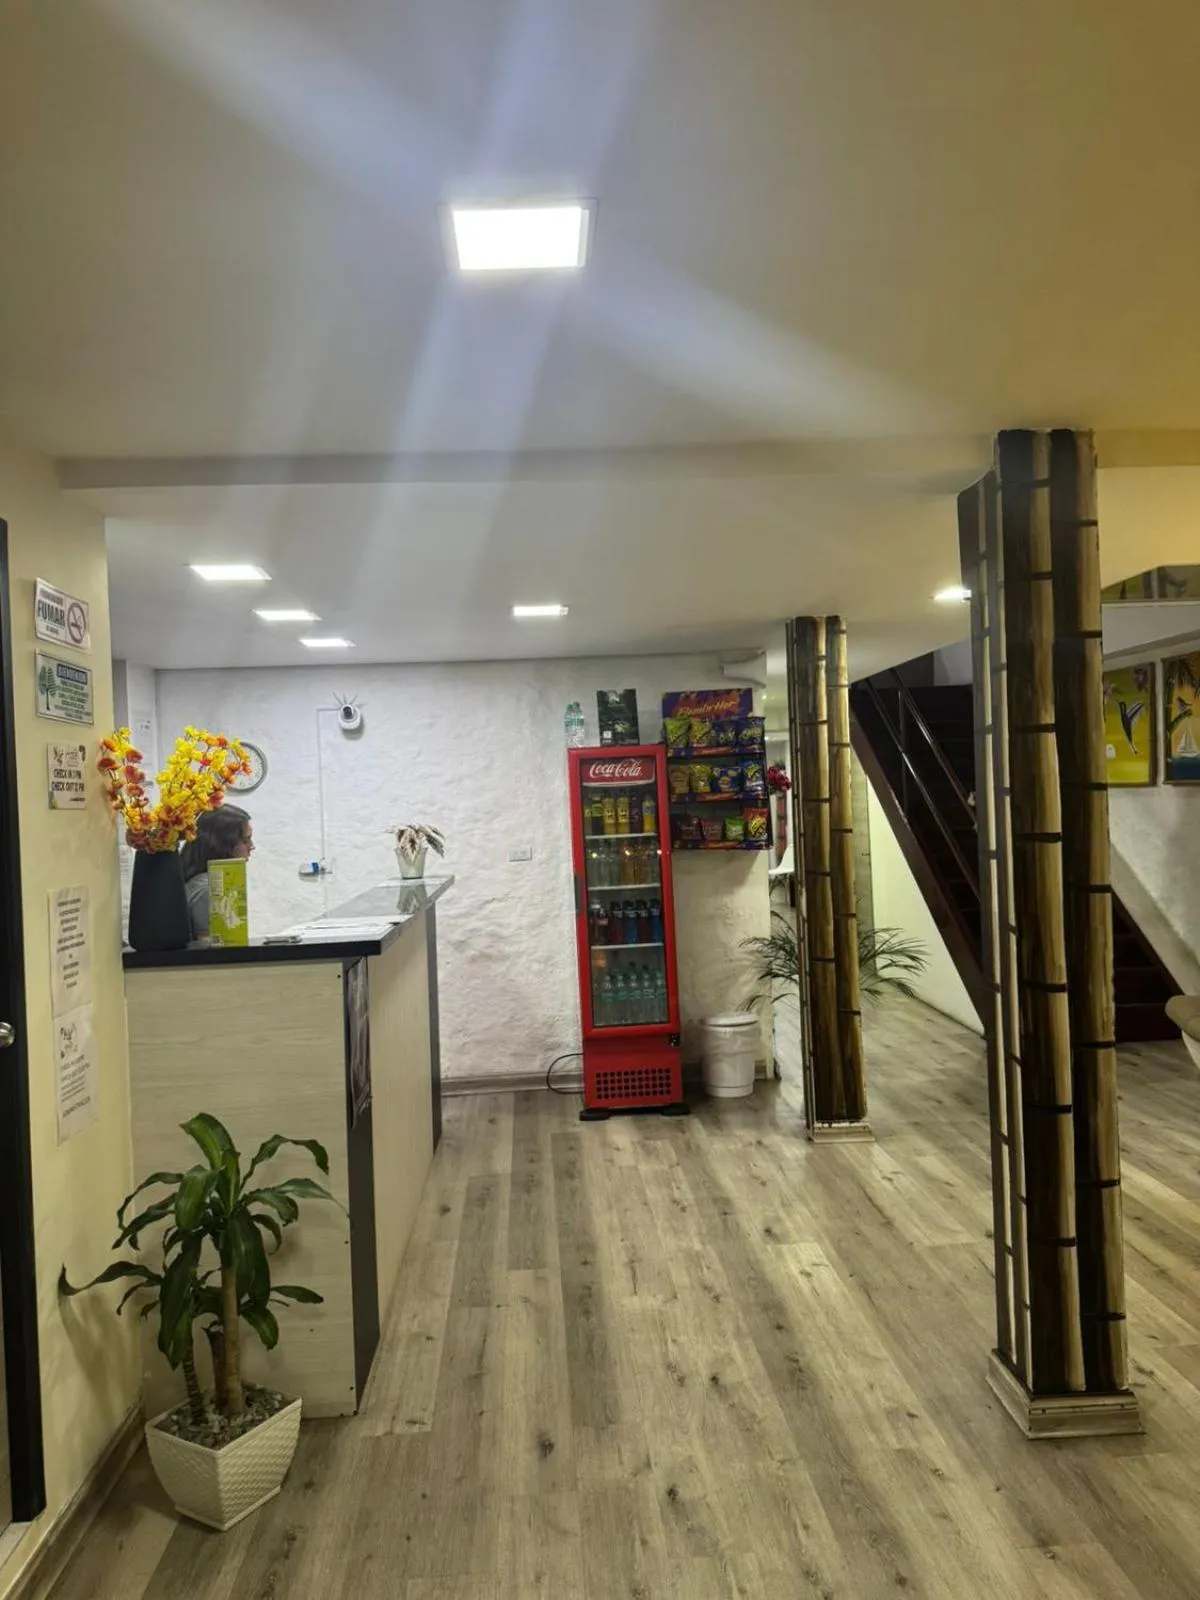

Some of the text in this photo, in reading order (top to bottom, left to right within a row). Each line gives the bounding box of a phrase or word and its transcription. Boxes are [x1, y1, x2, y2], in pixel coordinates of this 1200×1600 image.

[38, 600, 65, 627] FUMAR
[54, 769, 66, 779] CHECK
[589, 759, 642, 778] Coca-Cola
[52, 781, 65, 791] CHECK
